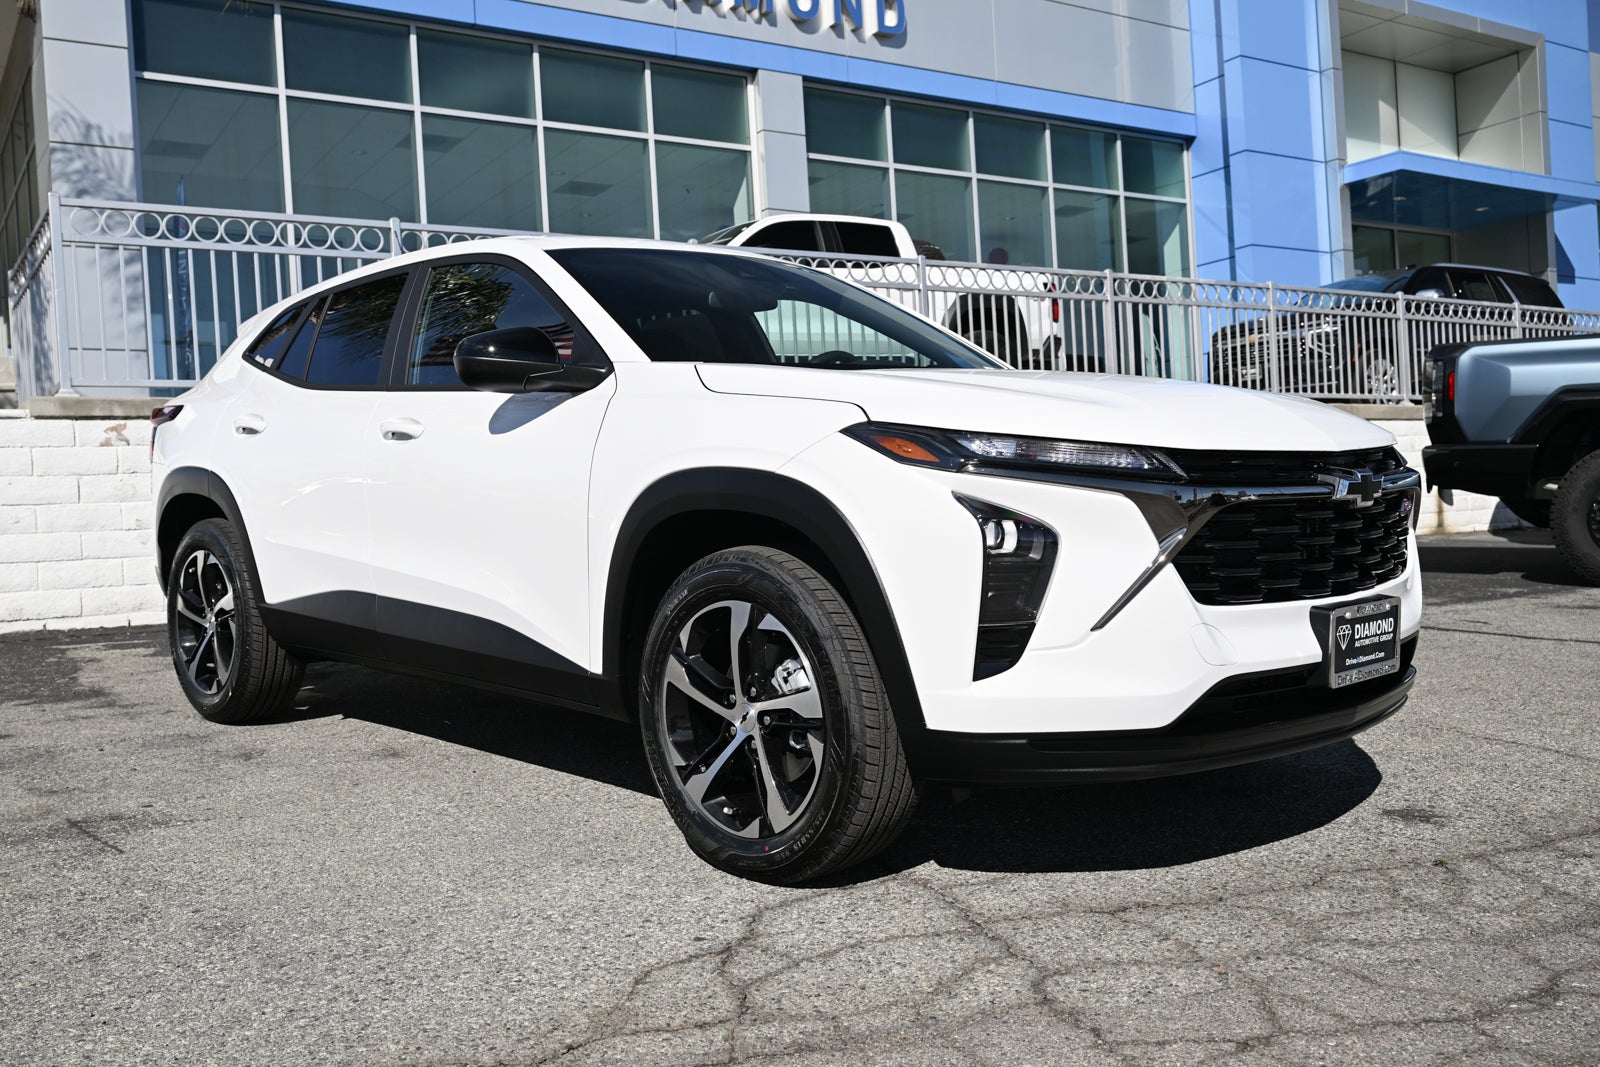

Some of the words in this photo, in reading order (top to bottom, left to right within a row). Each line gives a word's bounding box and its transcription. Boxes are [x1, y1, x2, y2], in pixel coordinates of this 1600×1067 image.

[1355, 618, 1394, 639] DIAMOND
[1355, 638, 1379, 647] AUTOMOTIVE
[1380, 633, 1393, 641] GROUP
